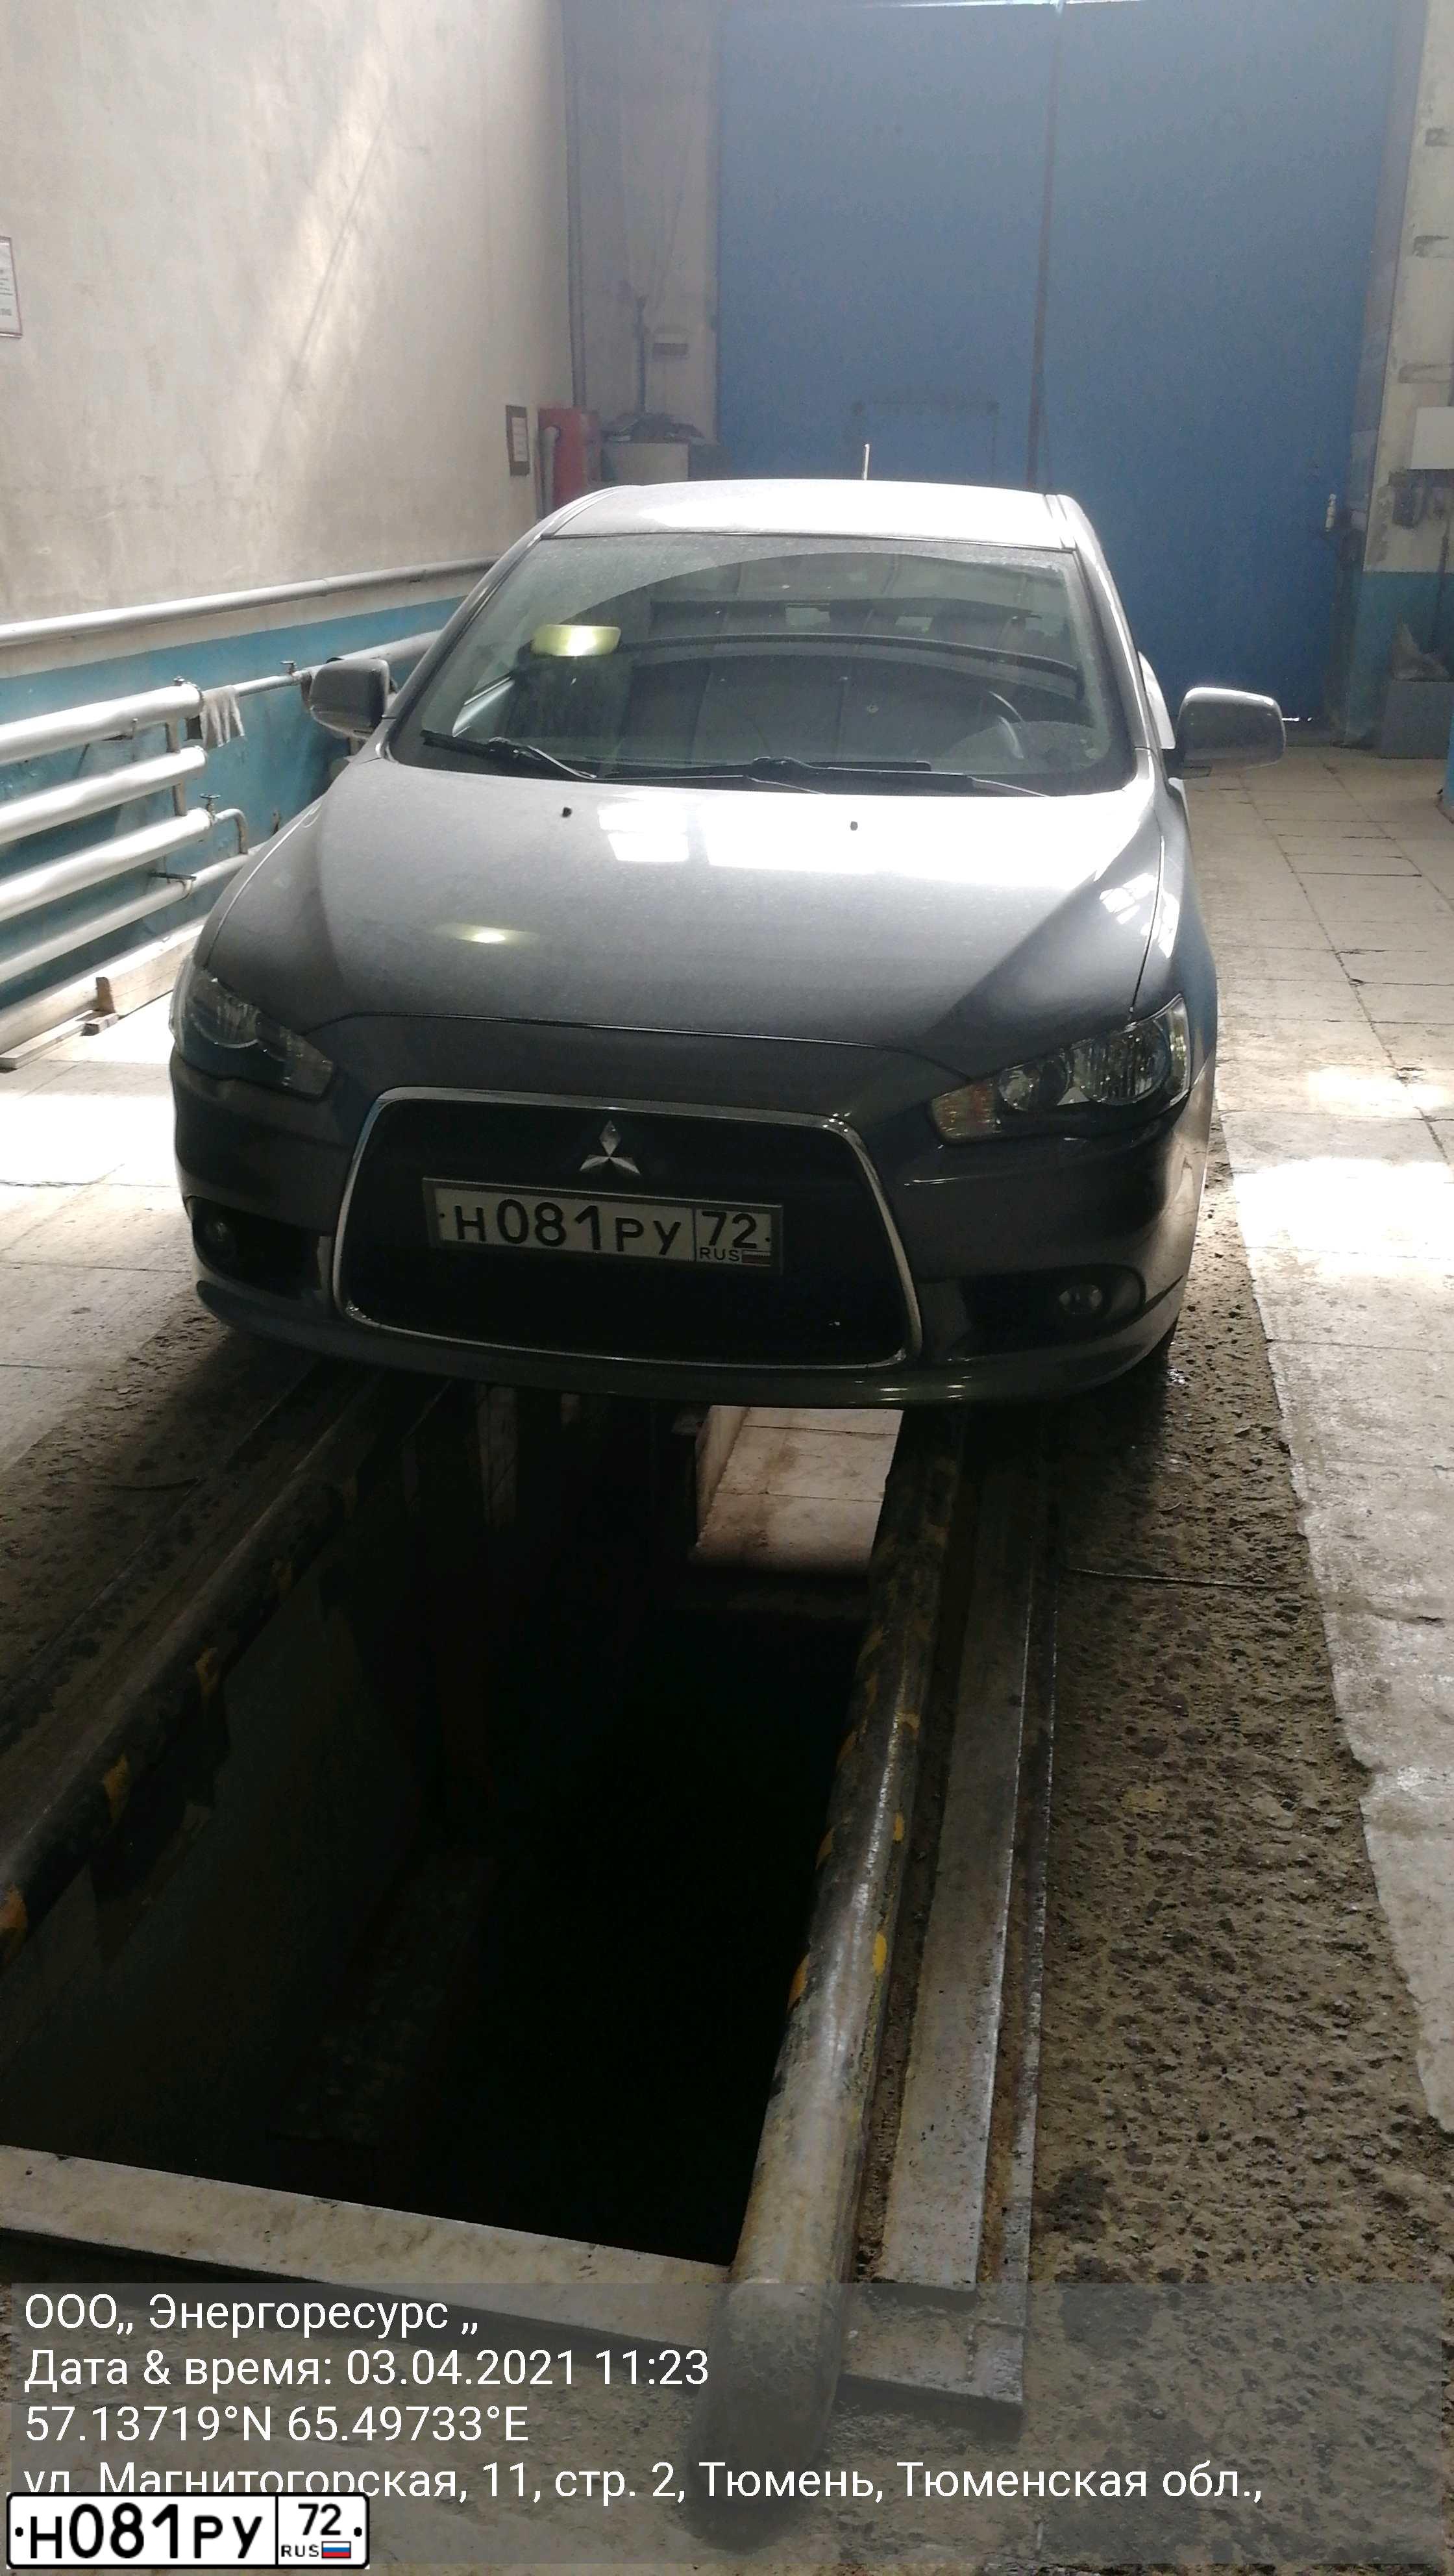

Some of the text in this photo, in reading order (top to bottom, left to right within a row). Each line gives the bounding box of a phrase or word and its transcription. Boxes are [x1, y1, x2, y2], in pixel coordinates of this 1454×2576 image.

[454, 1198, 757, 1255] Н081РУ 72
[700, 1246, 740, 1261] RUS
